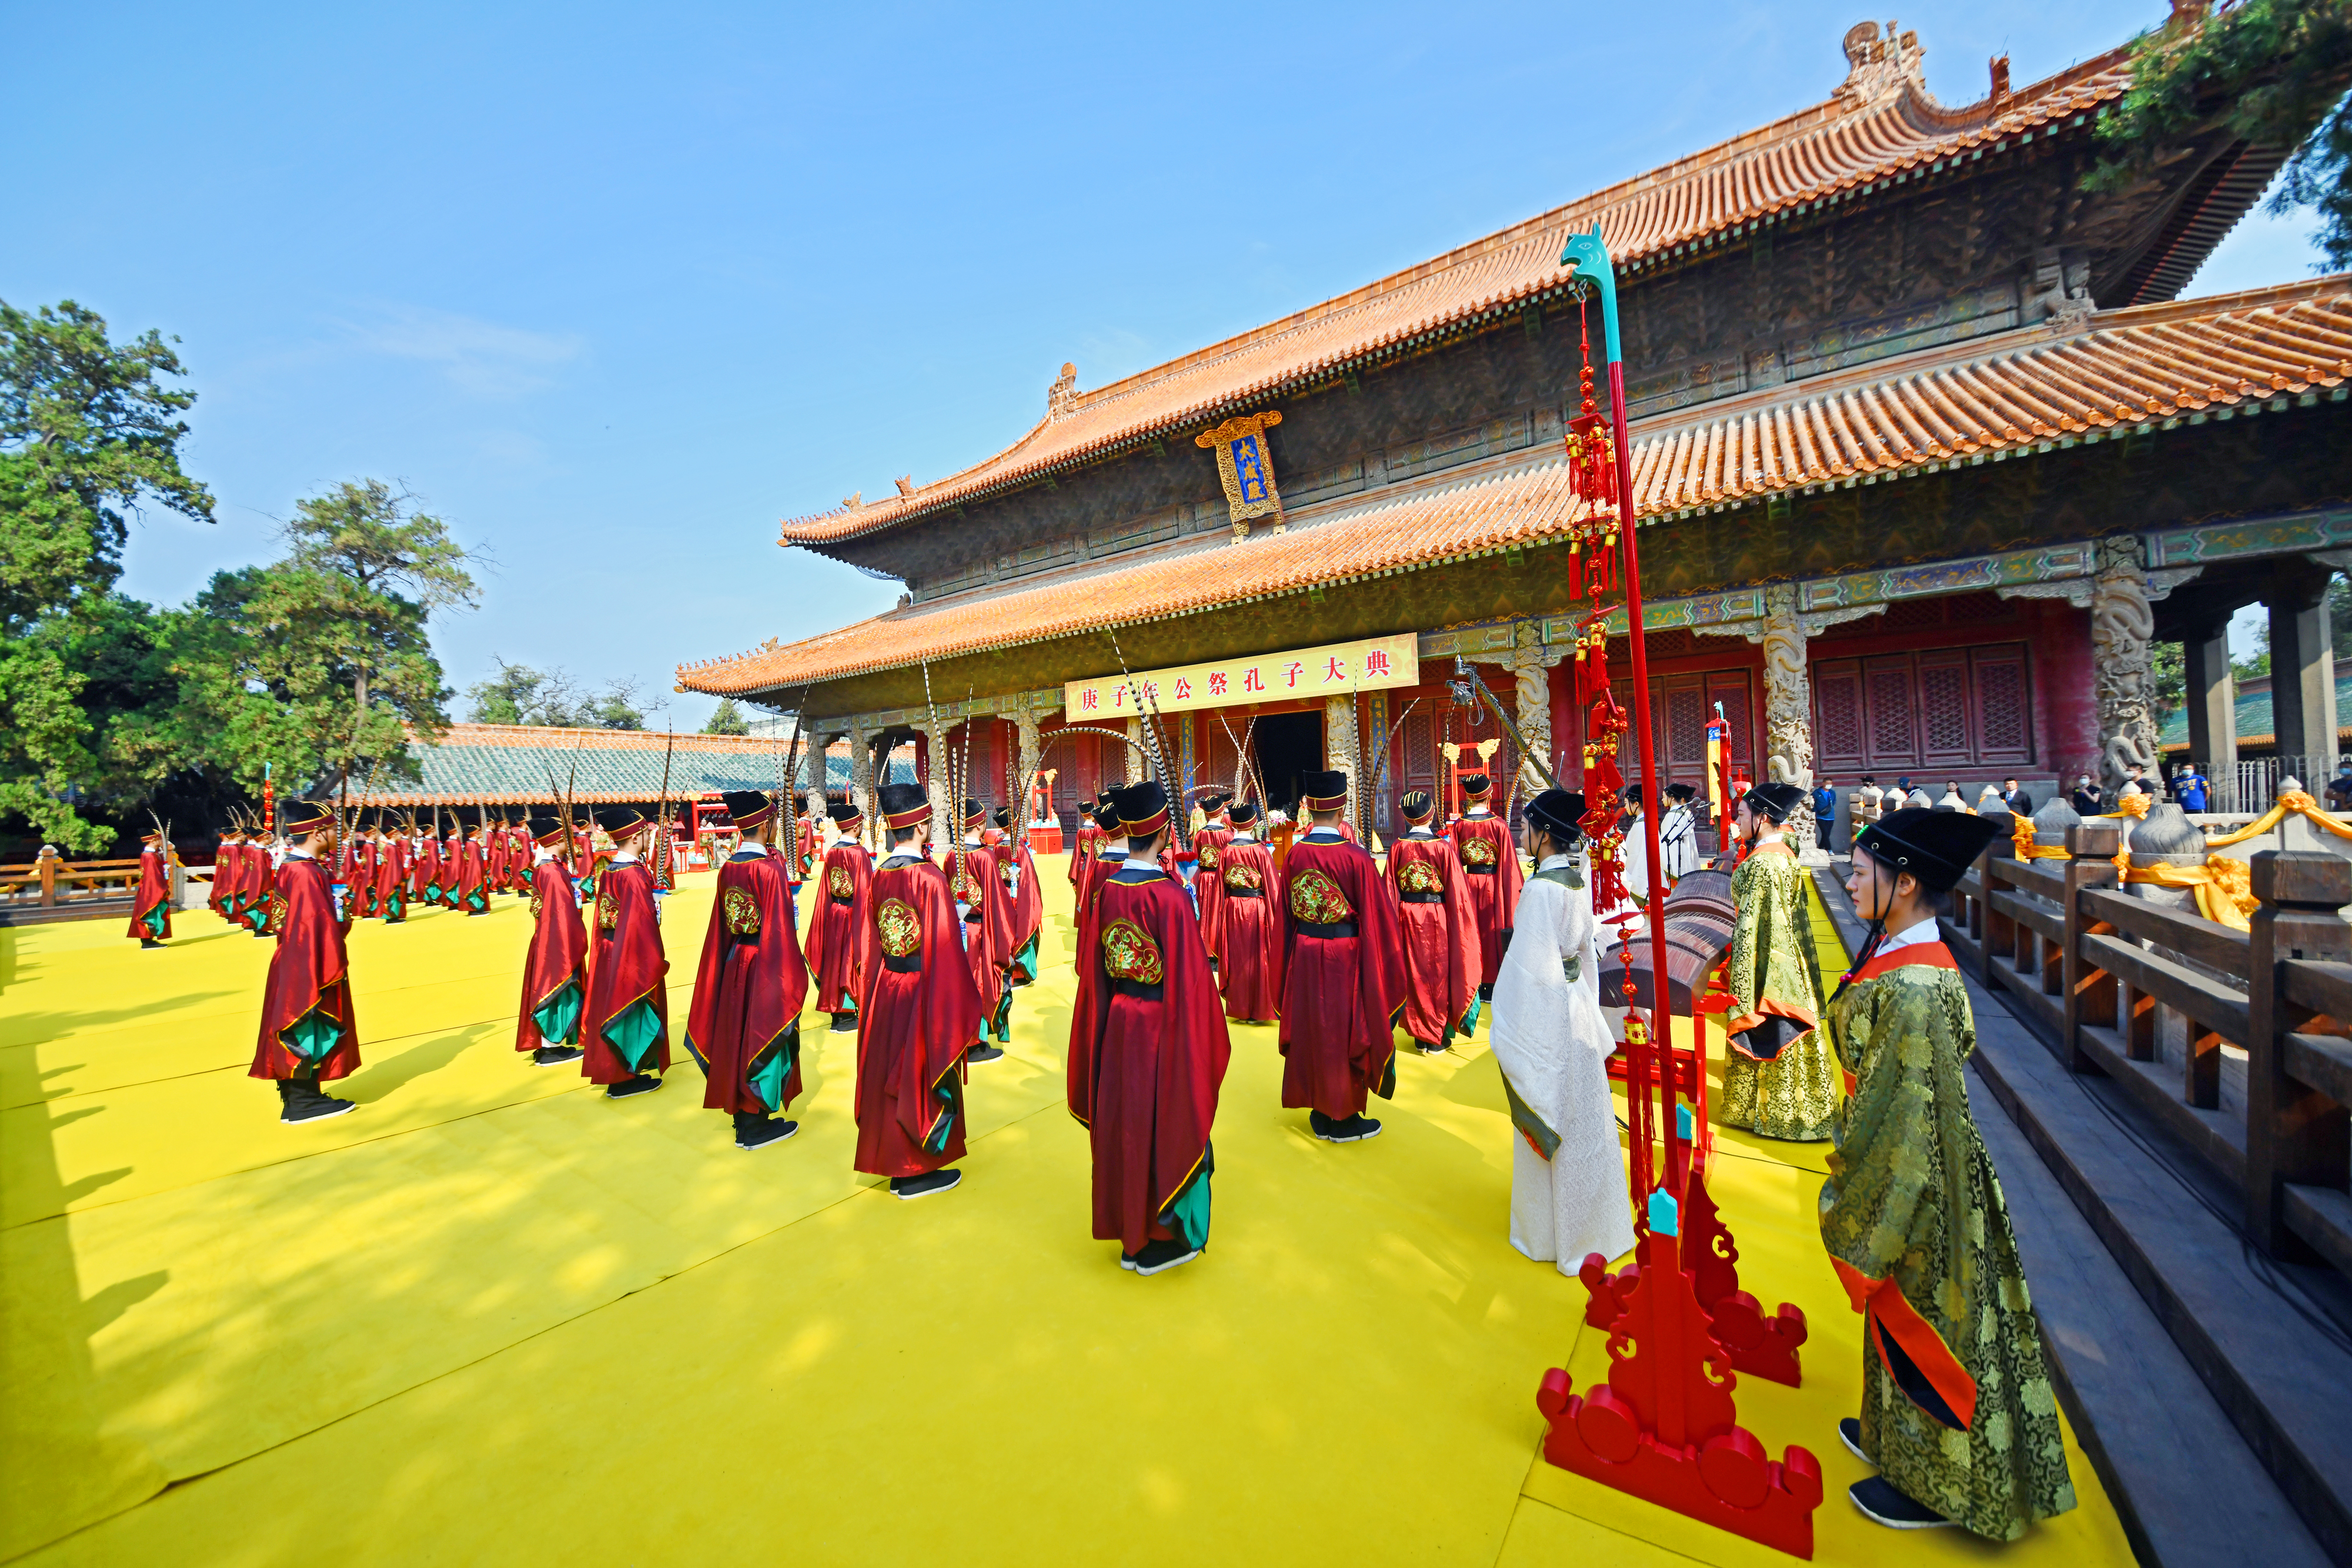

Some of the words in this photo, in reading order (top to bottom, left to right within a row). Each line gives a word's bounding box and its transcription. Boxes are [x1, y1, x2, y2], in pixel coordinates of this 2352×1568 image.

[1239, 440, 1265, 500] 大成殿
[1082, 650, 1391, 711] 庚子年公祭孔子大典
